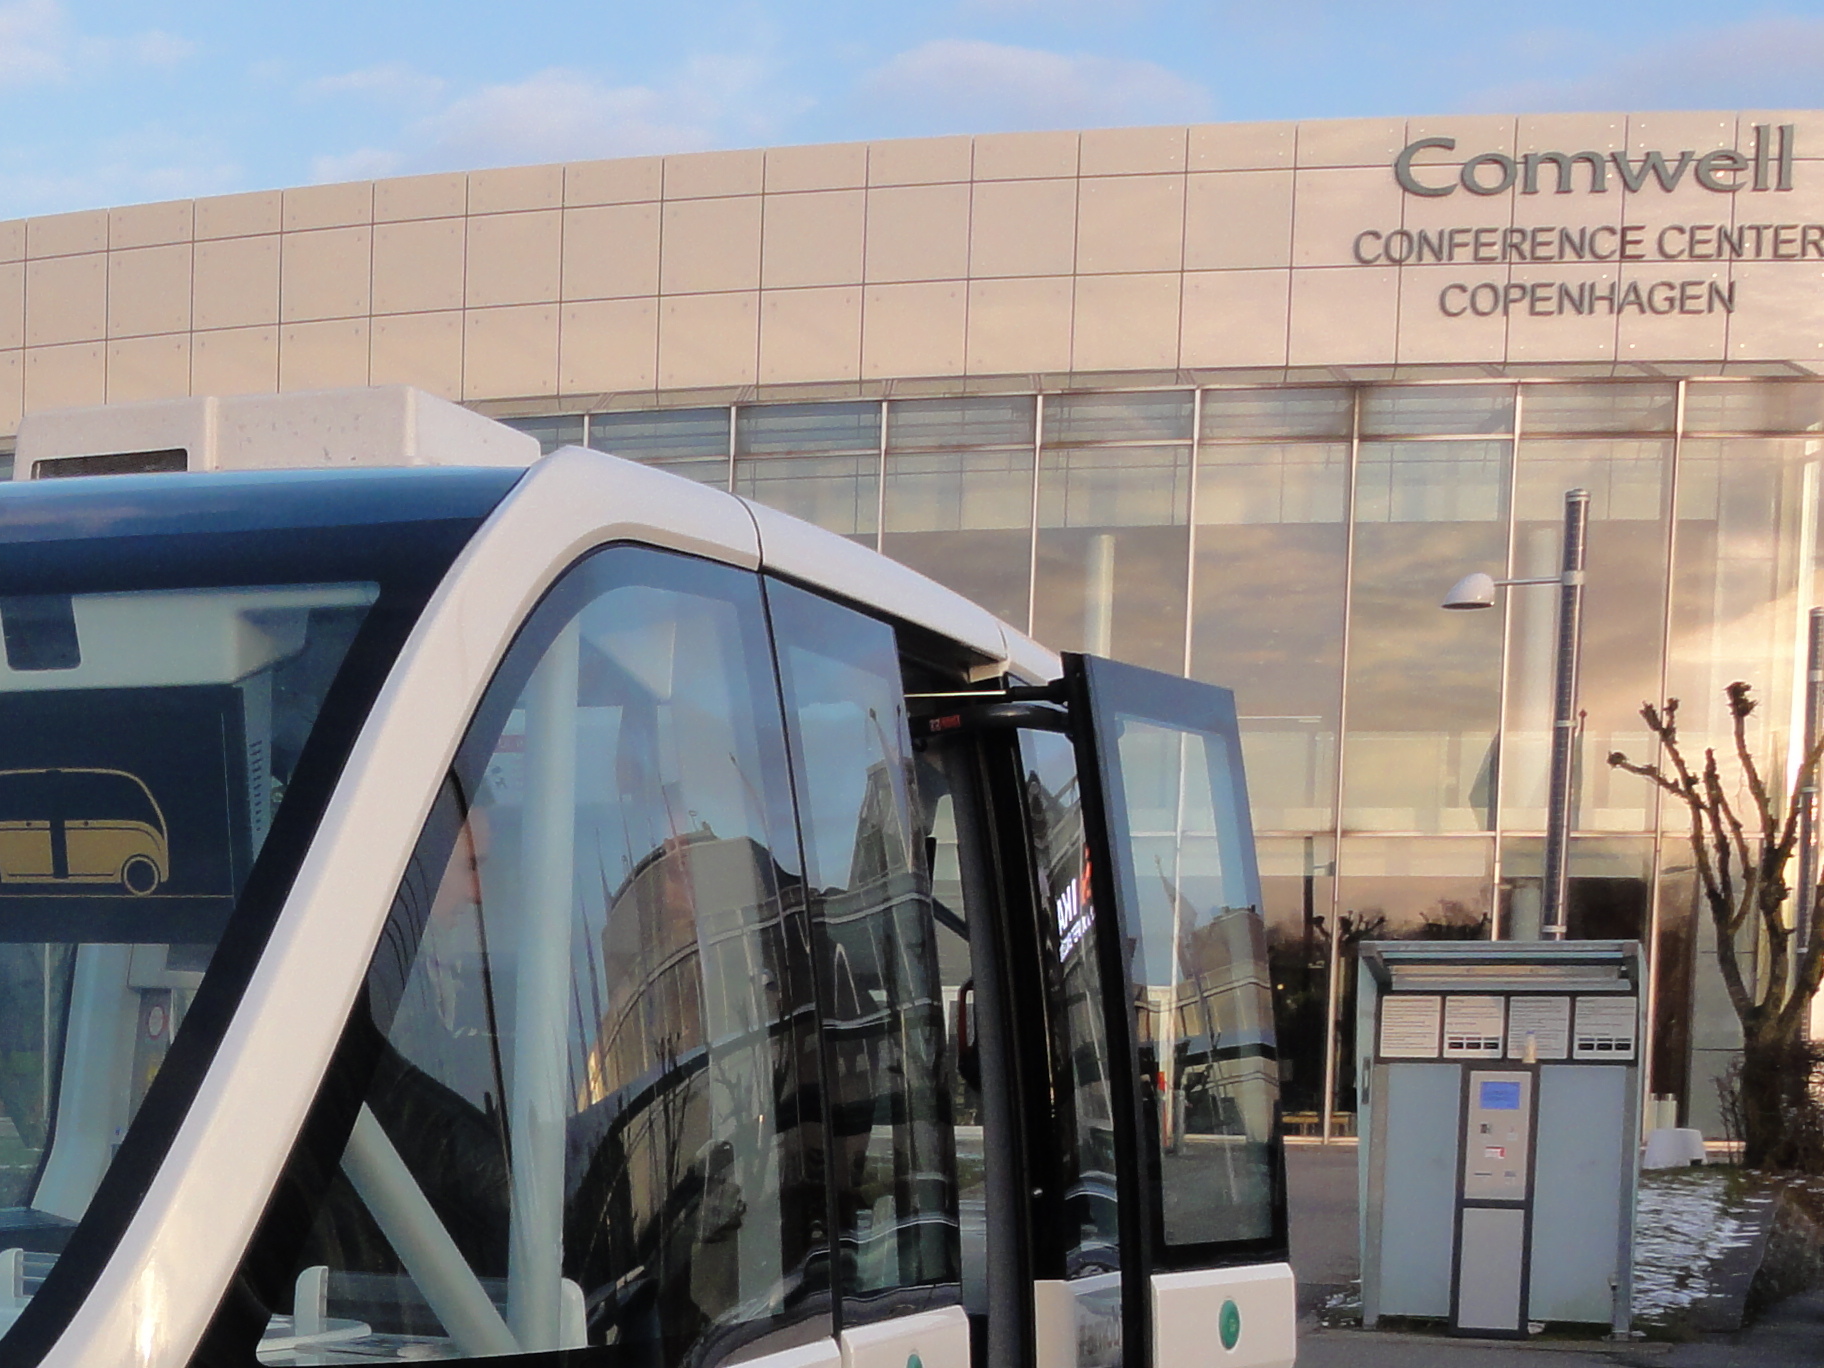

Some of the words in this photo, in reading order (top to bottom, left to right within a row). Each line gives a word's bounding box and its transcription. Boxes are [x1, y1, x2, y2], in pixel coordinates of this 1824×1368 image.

[1394, 123, 1795, 197] Comwell
[1353, 226, 1646, 265] CONFERENCE
[1657, 224, 1824, 260] CENTER
[1439, 280, 1736, 318] COPENHAGEN
